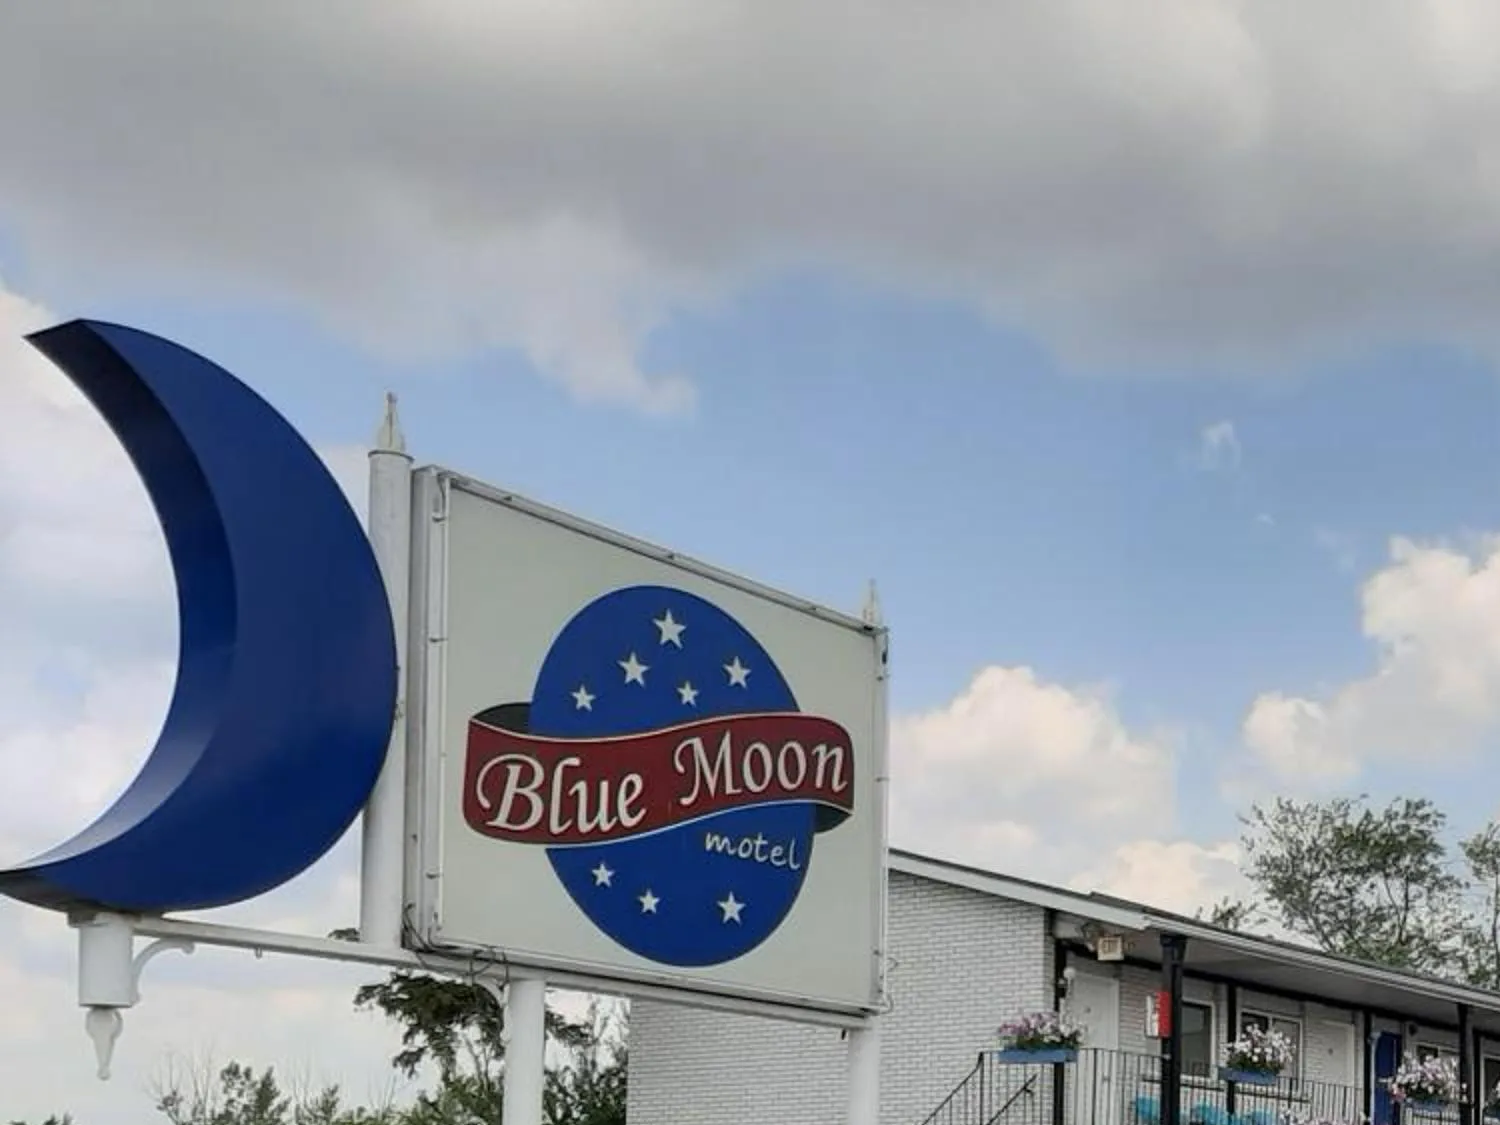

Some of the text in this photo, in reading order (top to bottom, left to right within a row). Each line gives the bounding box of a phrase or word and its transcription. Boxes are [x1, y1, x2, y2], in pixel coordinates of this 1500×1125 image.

[476, 729, 849, 835] Blue Moon
[704, 830, 801, 870] motel
